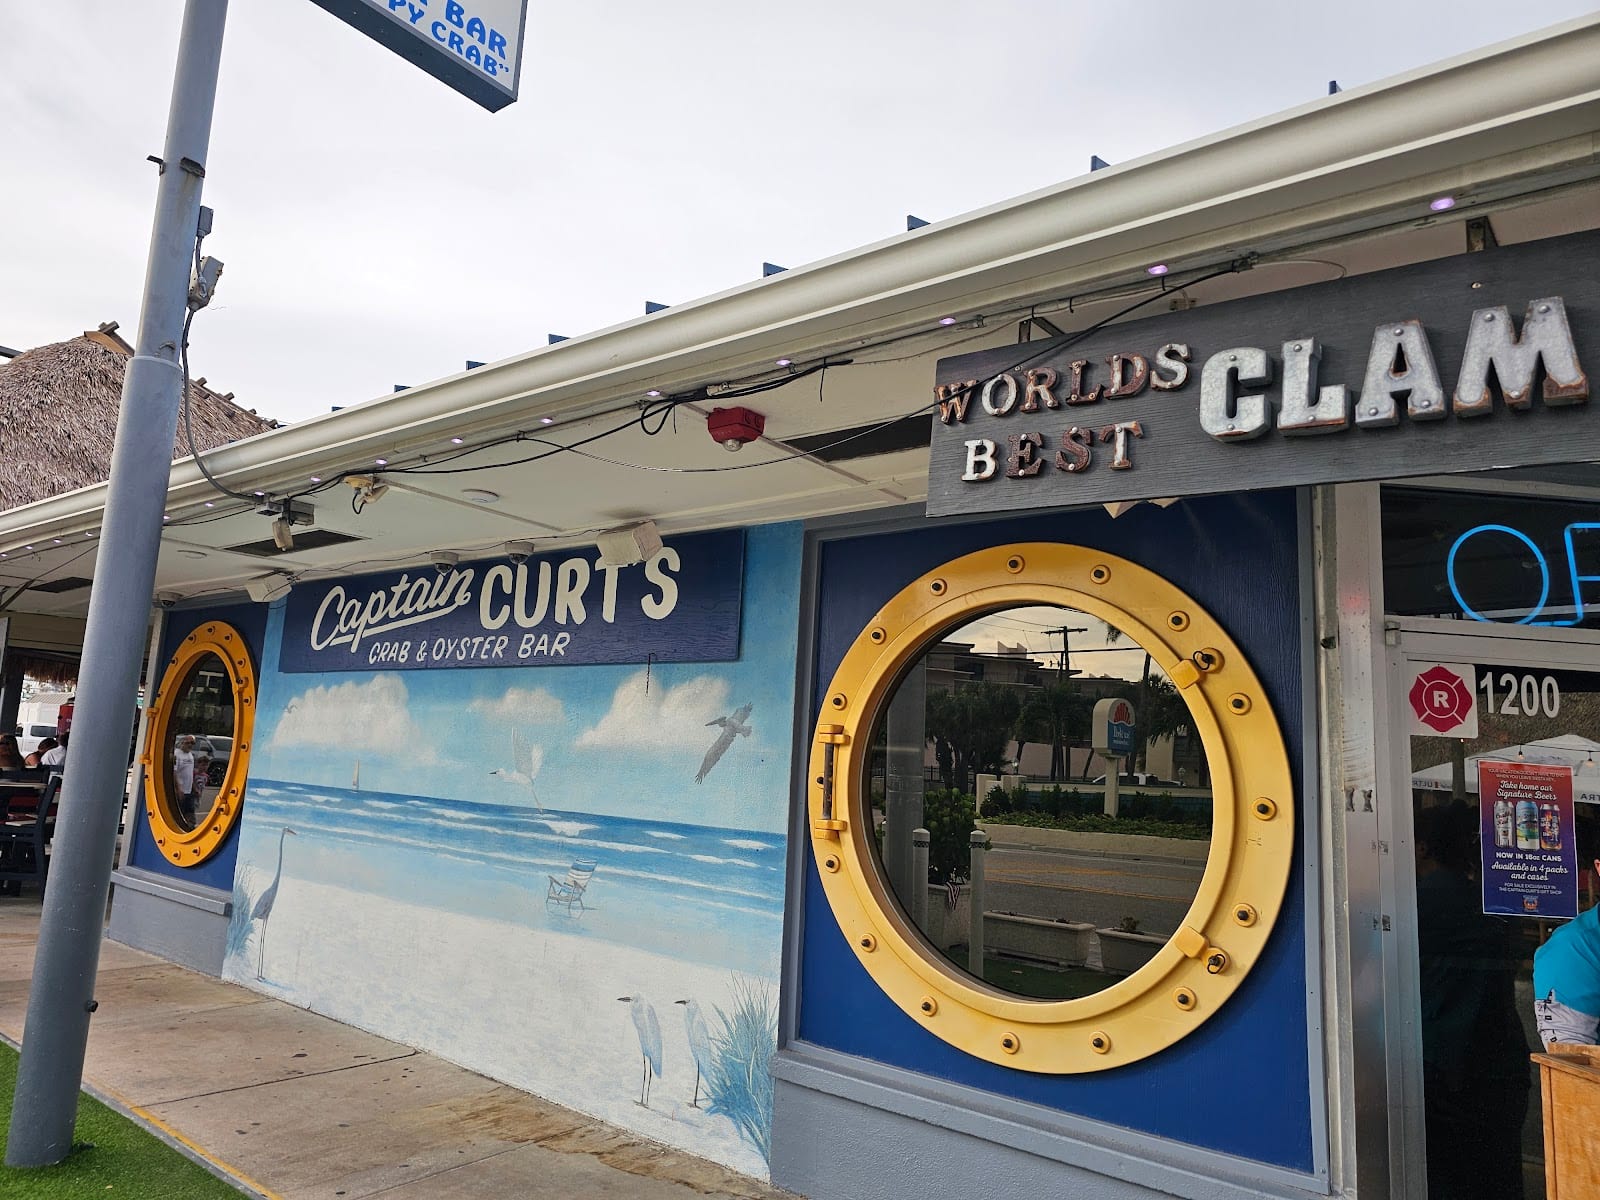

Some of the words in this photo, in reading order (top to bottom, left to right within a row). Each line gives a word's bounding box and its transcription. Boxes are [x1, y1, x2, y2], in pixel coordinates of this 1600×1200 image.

[445, 0, 507, 60] BAR
[934, 343, 1193, 424] WORLDS
[1199, 296, 1590, 443] CLAM
[960, 420, 1144, 482] BEST
[310, 568, 475, 654] Captain
[479, 546, 681, 630] CURTS
[368, 640, 412, 665] CRAB
[416, 640, 428, 662] &
[432, 635, 510, 662] OYSTER
[517, 631, 571, 659] BAR
[1432, 690, 1450, 709] R
[1479, 671, 1560, 719] 1200
[1496, 788, 1533, 800] Signature
[1534, 791, 1558, 801] Beers
[1500, 780, 1518, 790] Take
[1518, 782, 1539, 791] home
[1491, 861, 1529, 872] Available
[1530, 864, 1538, 872] in
[1539, 864, 1569, 876] 4-packs
[1510, 872, 1526, 880] and
